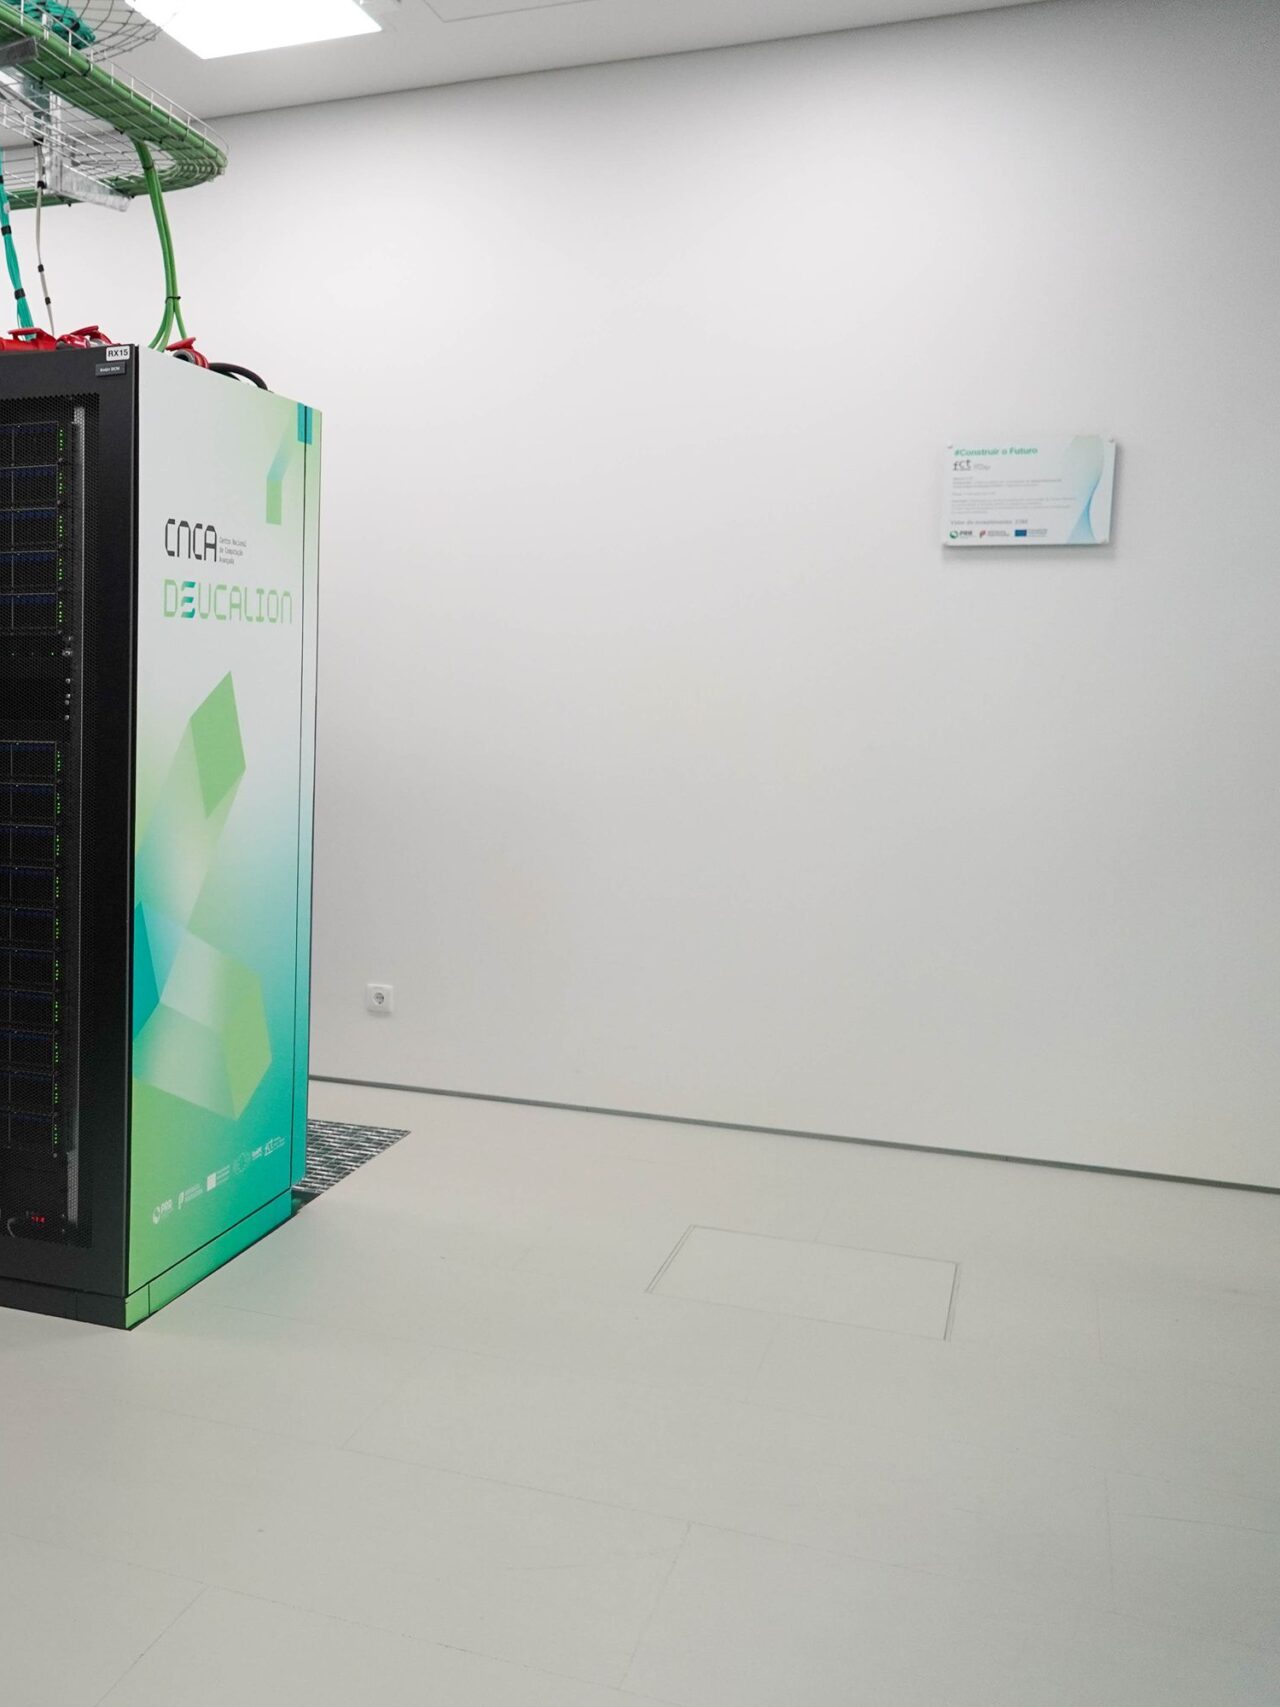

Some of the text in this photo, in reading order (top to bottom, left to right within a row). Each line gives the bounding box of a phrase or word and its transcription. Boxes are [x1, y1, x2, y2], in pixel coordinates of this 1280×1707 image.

[107, 349, 128, 358] RX15
[165, 518, 217, 562] CNCA
[163, 579, 293, 624] DEUCALION
